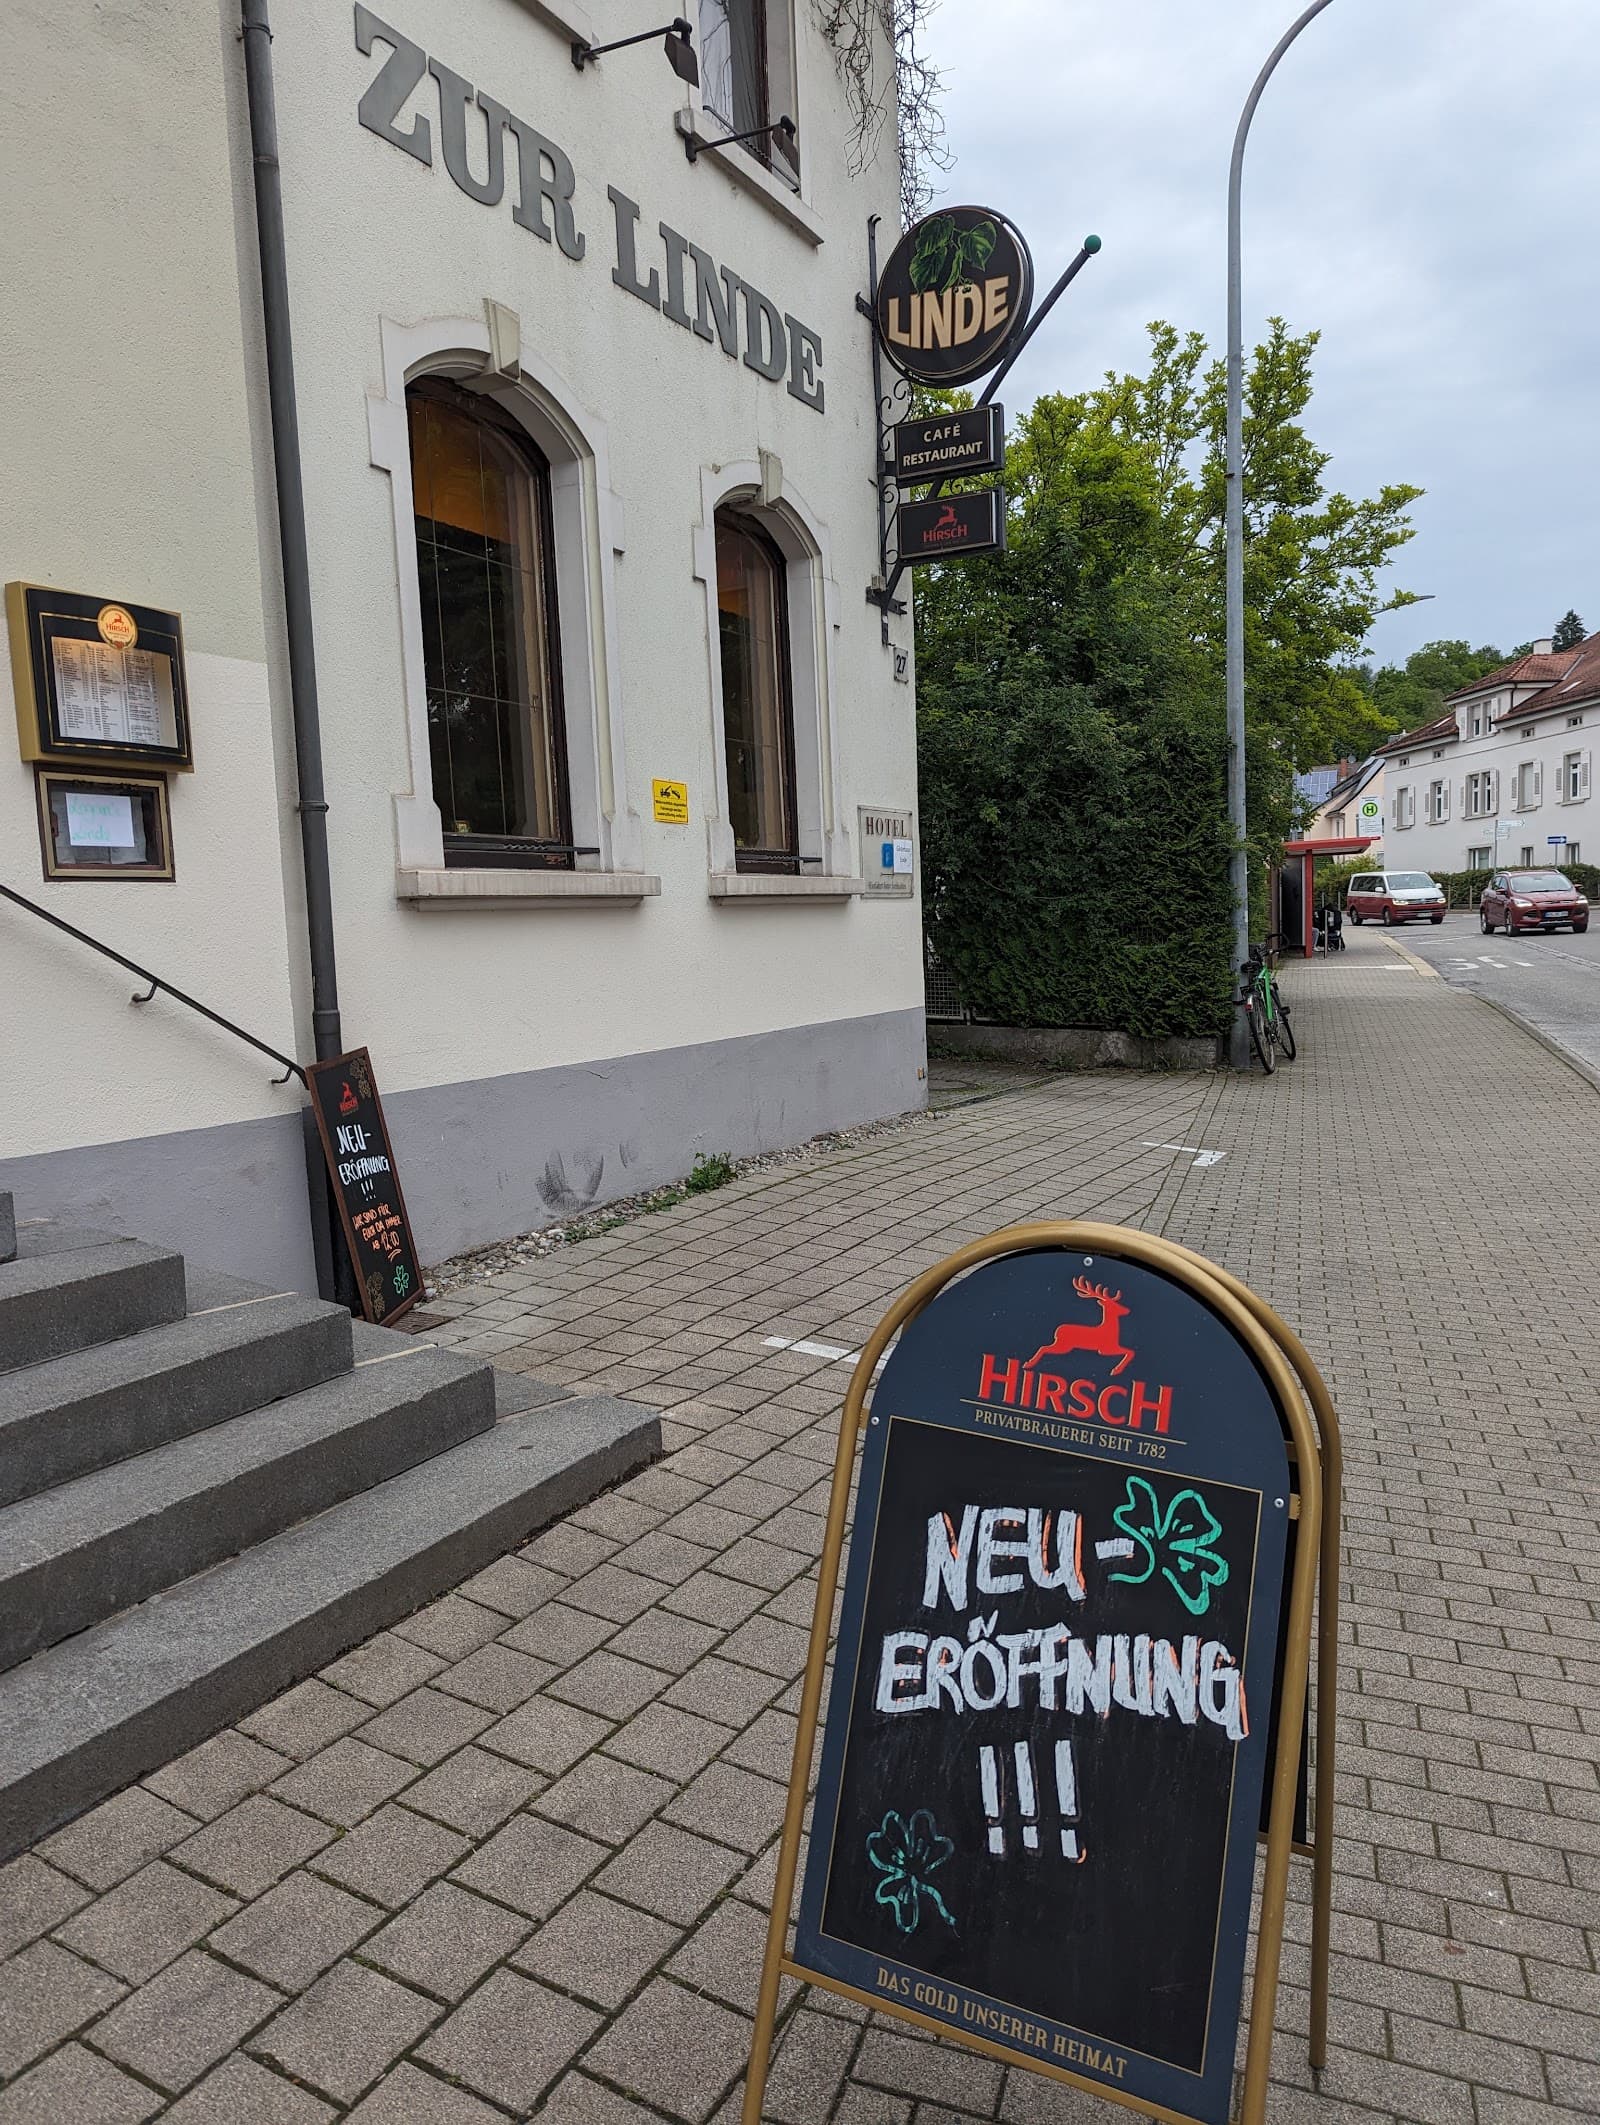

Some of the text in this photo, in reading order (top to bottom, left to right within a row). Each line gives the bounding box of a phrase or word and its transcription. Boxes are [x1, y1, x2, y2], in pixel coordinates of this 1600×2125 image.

[355, 2, 825, 414] ZUR LINDE
[888, 275, 1010, 350] LINDE
[923, 423, 961, 442] CAFÉ
[902, 441, 983, 467] RESTAURANT
[923, 524, 968, 543] HIRSCH
[896, 654, 907, 674] 27
[865, 816, 908, 837] HOTEL
[338, 1156, 390, 1186] ERÖFFNUNG
[977, 1353, 1173, 1434] HIRSCH
[975, 1409, 1166, 1460] PRIVATBRAUEREI SEIT 1782
[876, 1610, 1250, 1741] ERÖFFNUNG
[876, 1967, 1129, 2079] DAS GOLD UNSERER HEIMAT
